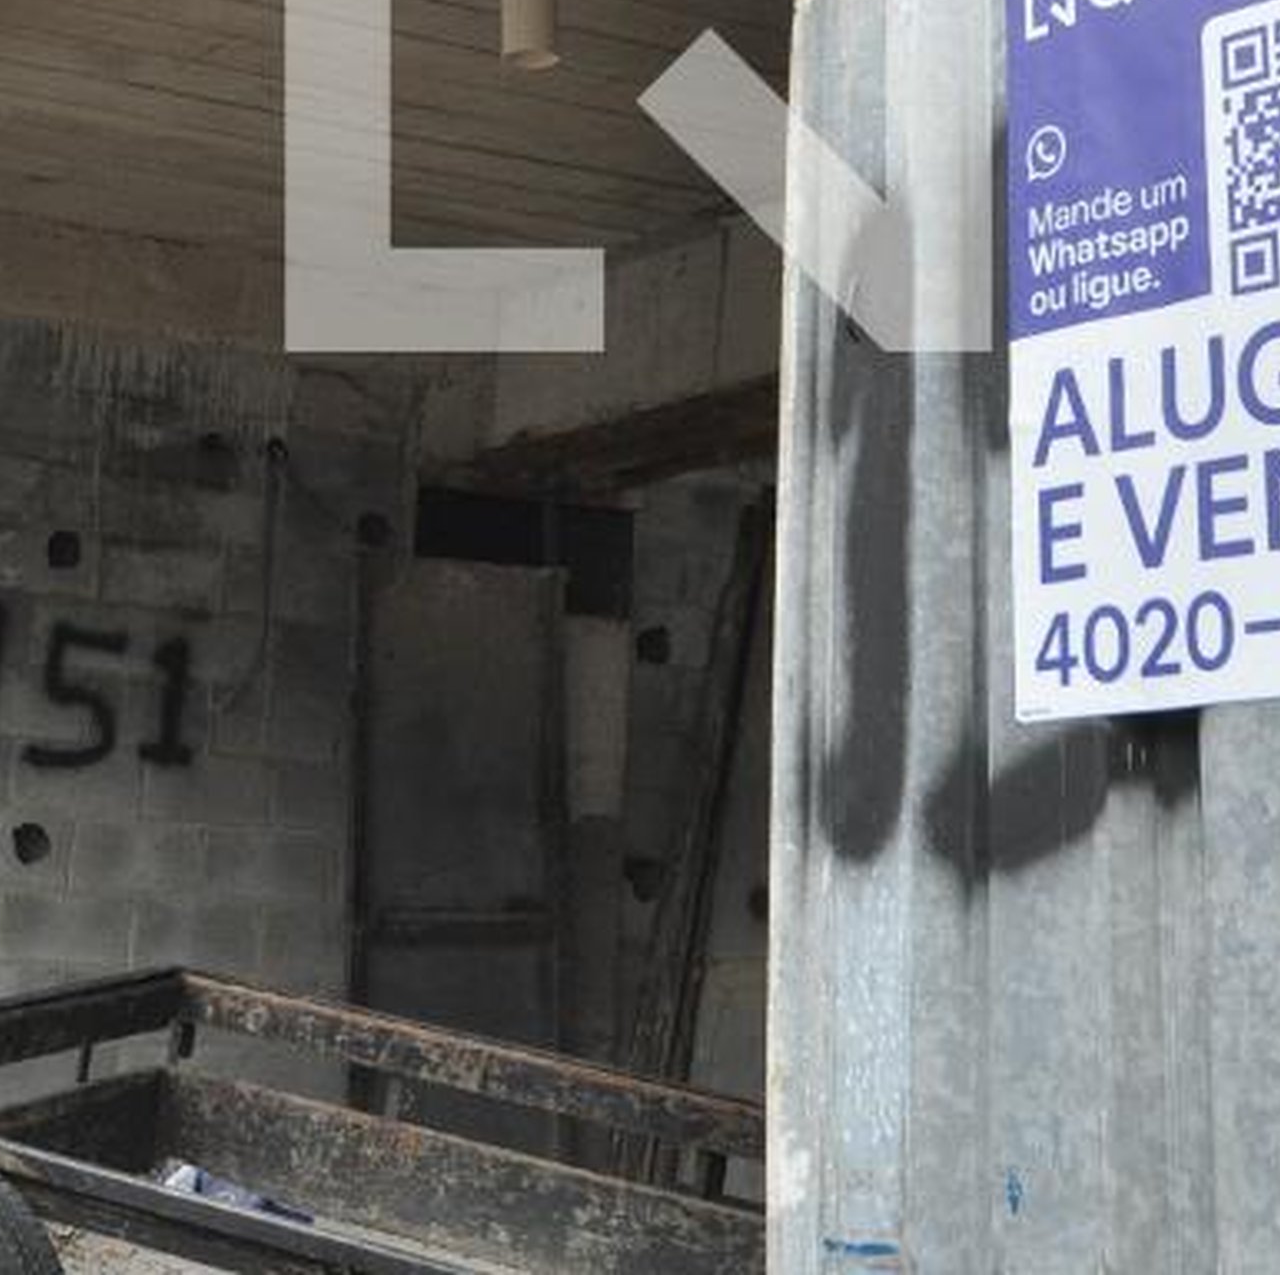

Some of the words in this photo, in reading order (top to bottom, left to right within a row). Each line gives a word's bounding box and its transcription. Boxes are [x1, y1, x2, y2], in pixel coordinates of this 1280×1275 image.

[1028, 187, 1133, 240] Mande
[1140, 173, 1187, 211] um
[1028, 215, 1190, 277] Whatsapp
[1030, 284, 1066, 316] ou
[1073, 266, 1161, 310] ligue.
[1037, 482, 1087, 585] E
